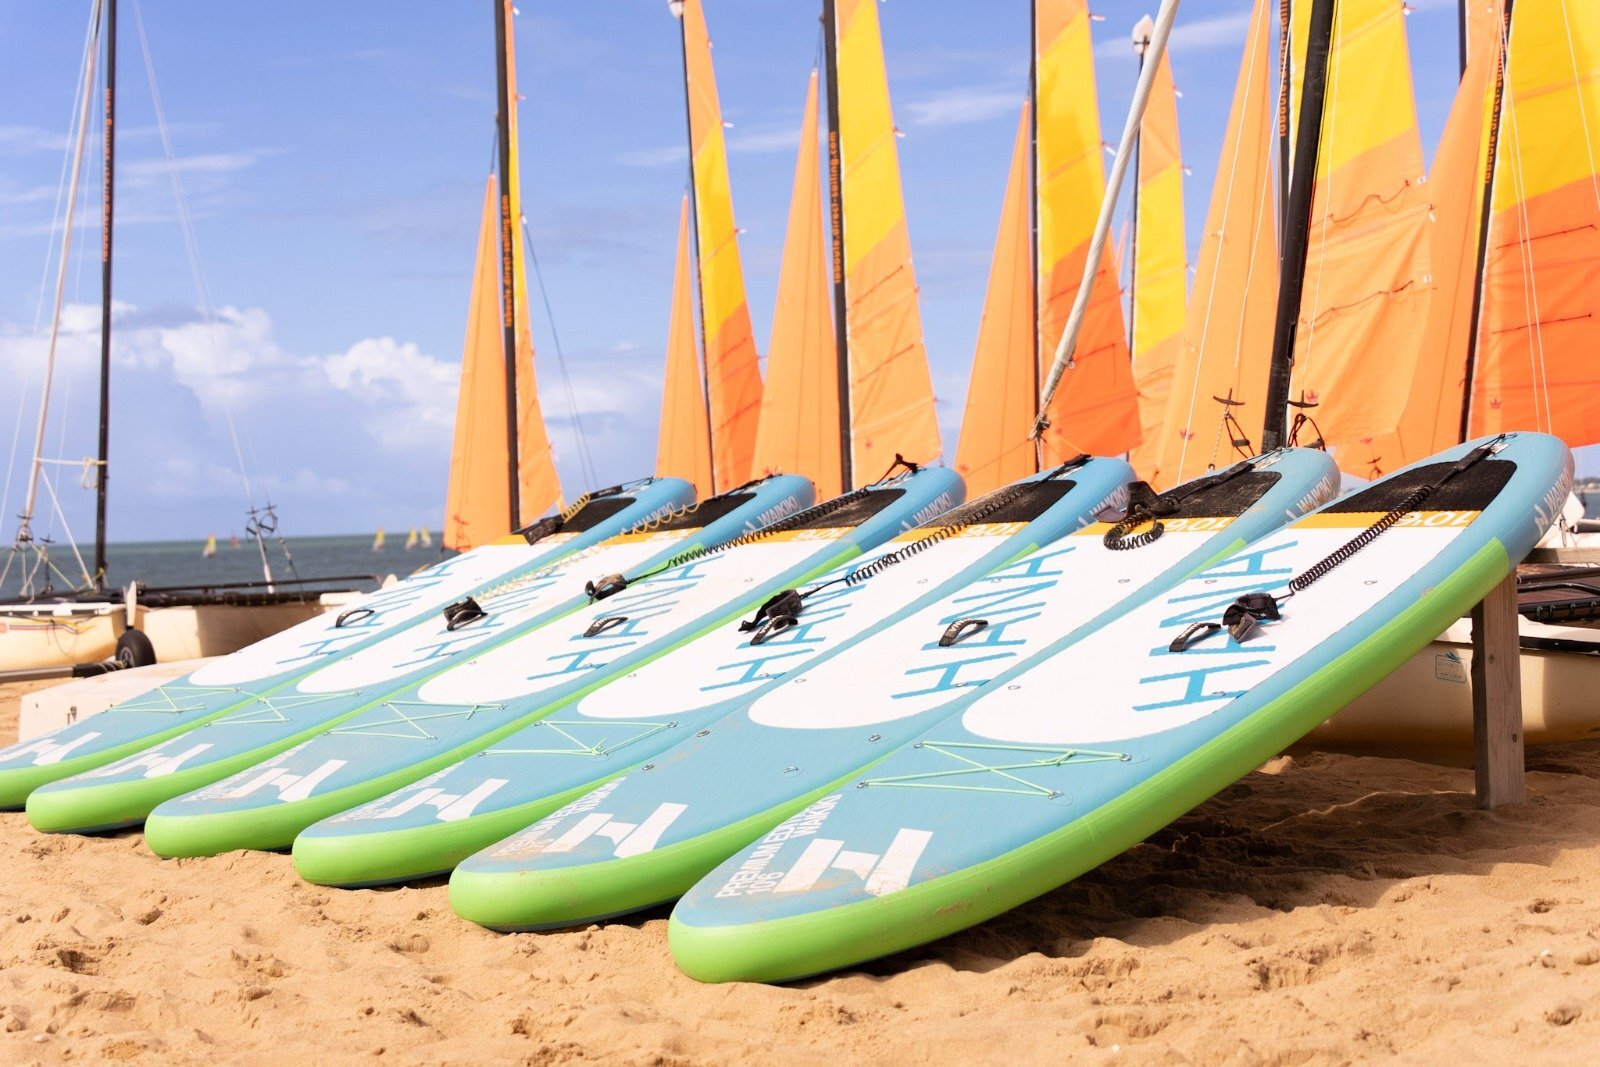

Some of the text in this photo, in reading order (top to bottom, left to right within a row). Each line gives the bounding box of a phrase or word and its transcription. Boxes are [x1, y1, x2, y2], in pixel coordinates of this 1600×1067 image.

[829, 131, 842, 284] labaule.direct-sailing.com
[527, 554, 725, 680] HANA
[890, 546, 1076, 699] HANA
[1132, 540, 1298, 712] HANA
